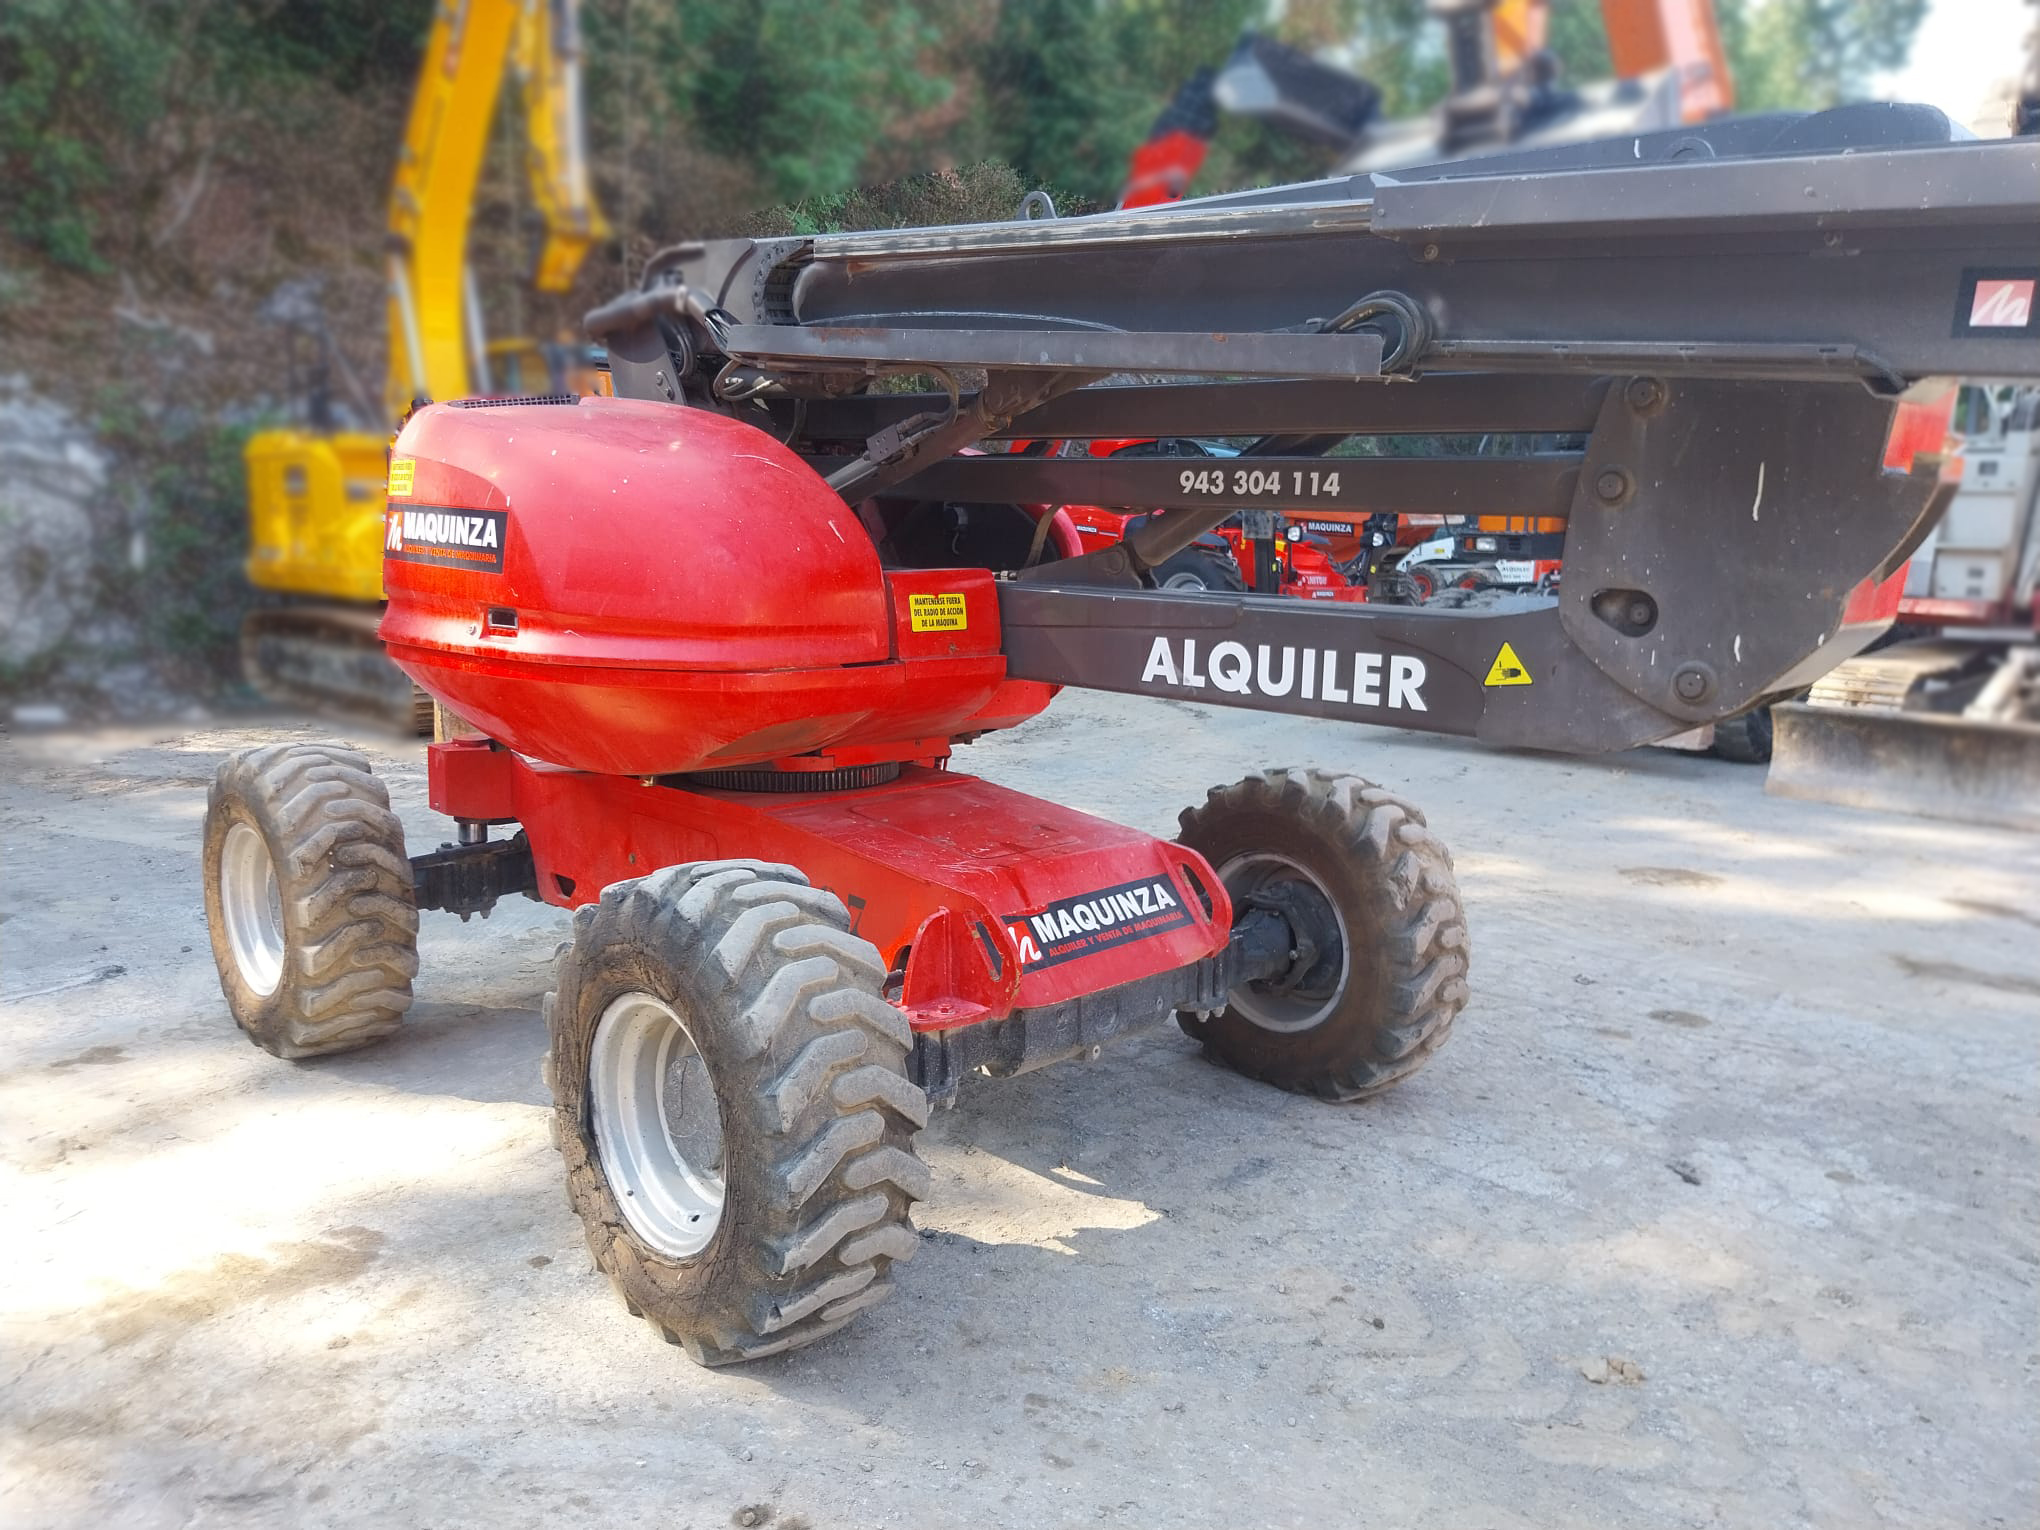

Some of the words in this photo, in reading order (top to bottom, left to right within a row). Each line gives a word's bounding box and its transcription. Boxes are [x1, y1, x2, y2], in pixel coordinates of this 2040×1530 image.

[1179, 469, 1225, 495] 943
[1232, 471, 1281, 496] 304
[1292, 471, 1341, 497] 114
[403, 511, 498, 548] MAQUINZA
[1308, 521, 1352, 533] MAQUINZA
[914, 597, 945, 605] MANTENERSE
[946, 596, 961, 605] FUERA
[914, 609, 922, 617] DEL
[924, 608, 939, 616] RADIO
[940, 608, 947, 616] DE
[929, 619, 935, 627] LA
[1141, 636, 1428, 712] ALQUILER
[1030, 883, 1176, 944] MAQUINZA
[1049, 938, 1088, 957] ALQUILER
[1088, 936, 1095, 945] Y
[1095, 929, 1122, 944] VENTA
[1122, 925, 1134, 935] DE
[1134, 911, 1184, 931] MAQUINARIA
